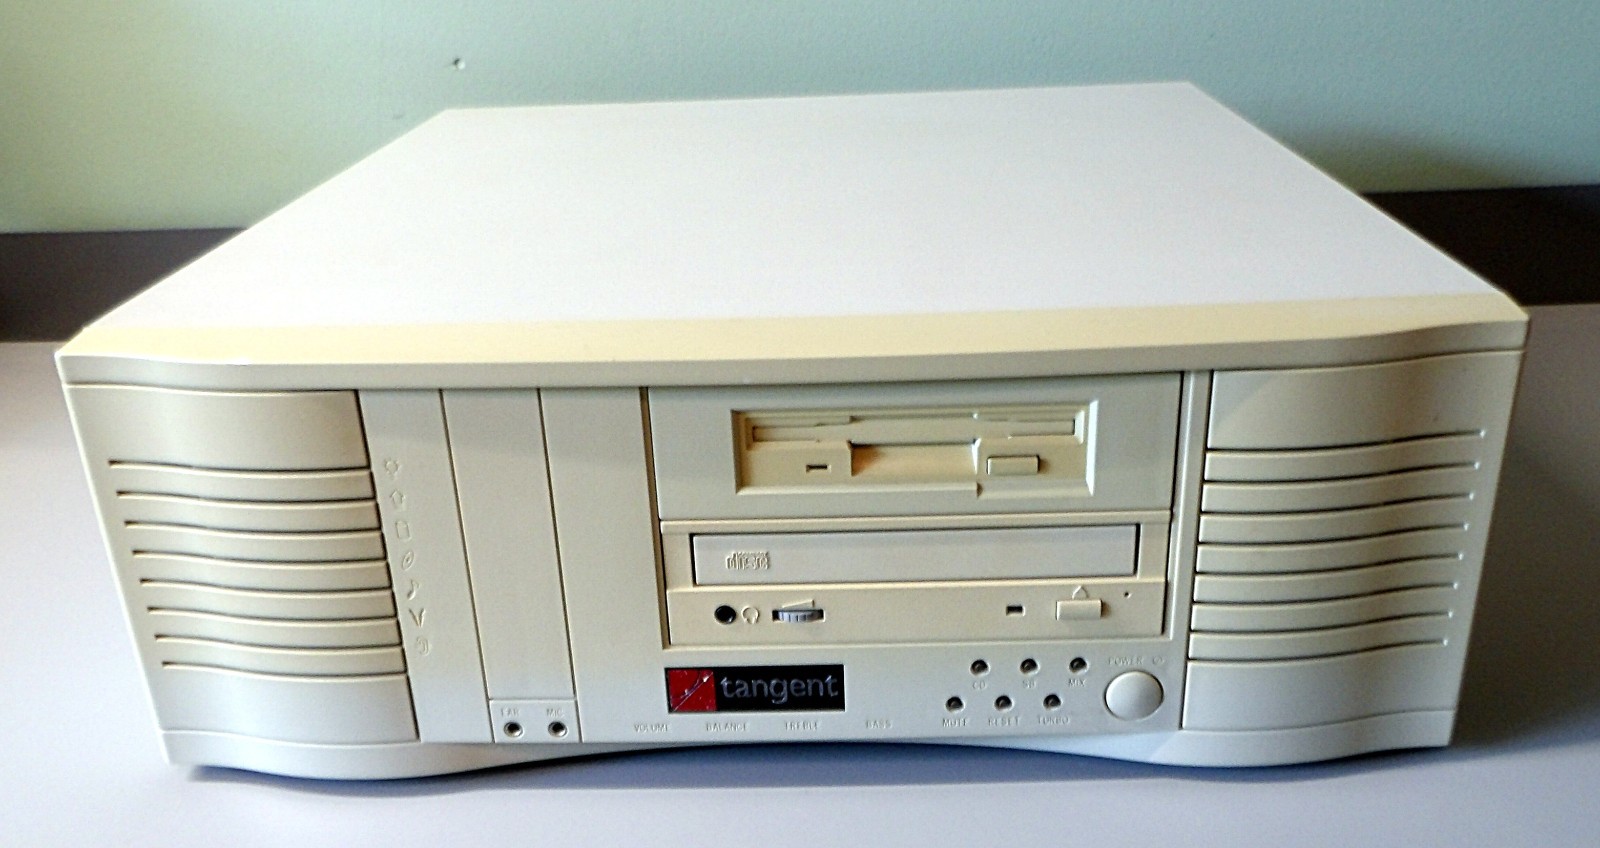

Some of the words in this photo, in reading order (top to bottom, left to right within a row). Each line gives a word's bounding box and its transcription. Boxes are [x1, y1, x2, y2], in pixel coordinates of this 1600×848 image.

[1107, 656, 1145, 666] POWER
[1067, 677, 1087, 688] MIX
[720, 674, 838, 704] tangent
[546, 707, 565, 717] MIC
[784, 720, 820, 731] TREBLE
[865, 719, 892, 729] BASS
[942, 718, 969, 728] MUTE
[988, 716, 1020, 727] RESET
[1037, 715, 1070, 726] TURBO
[633, 722, 670, 733] VOLUME
[705, 721, 748, 732] BALANCE
